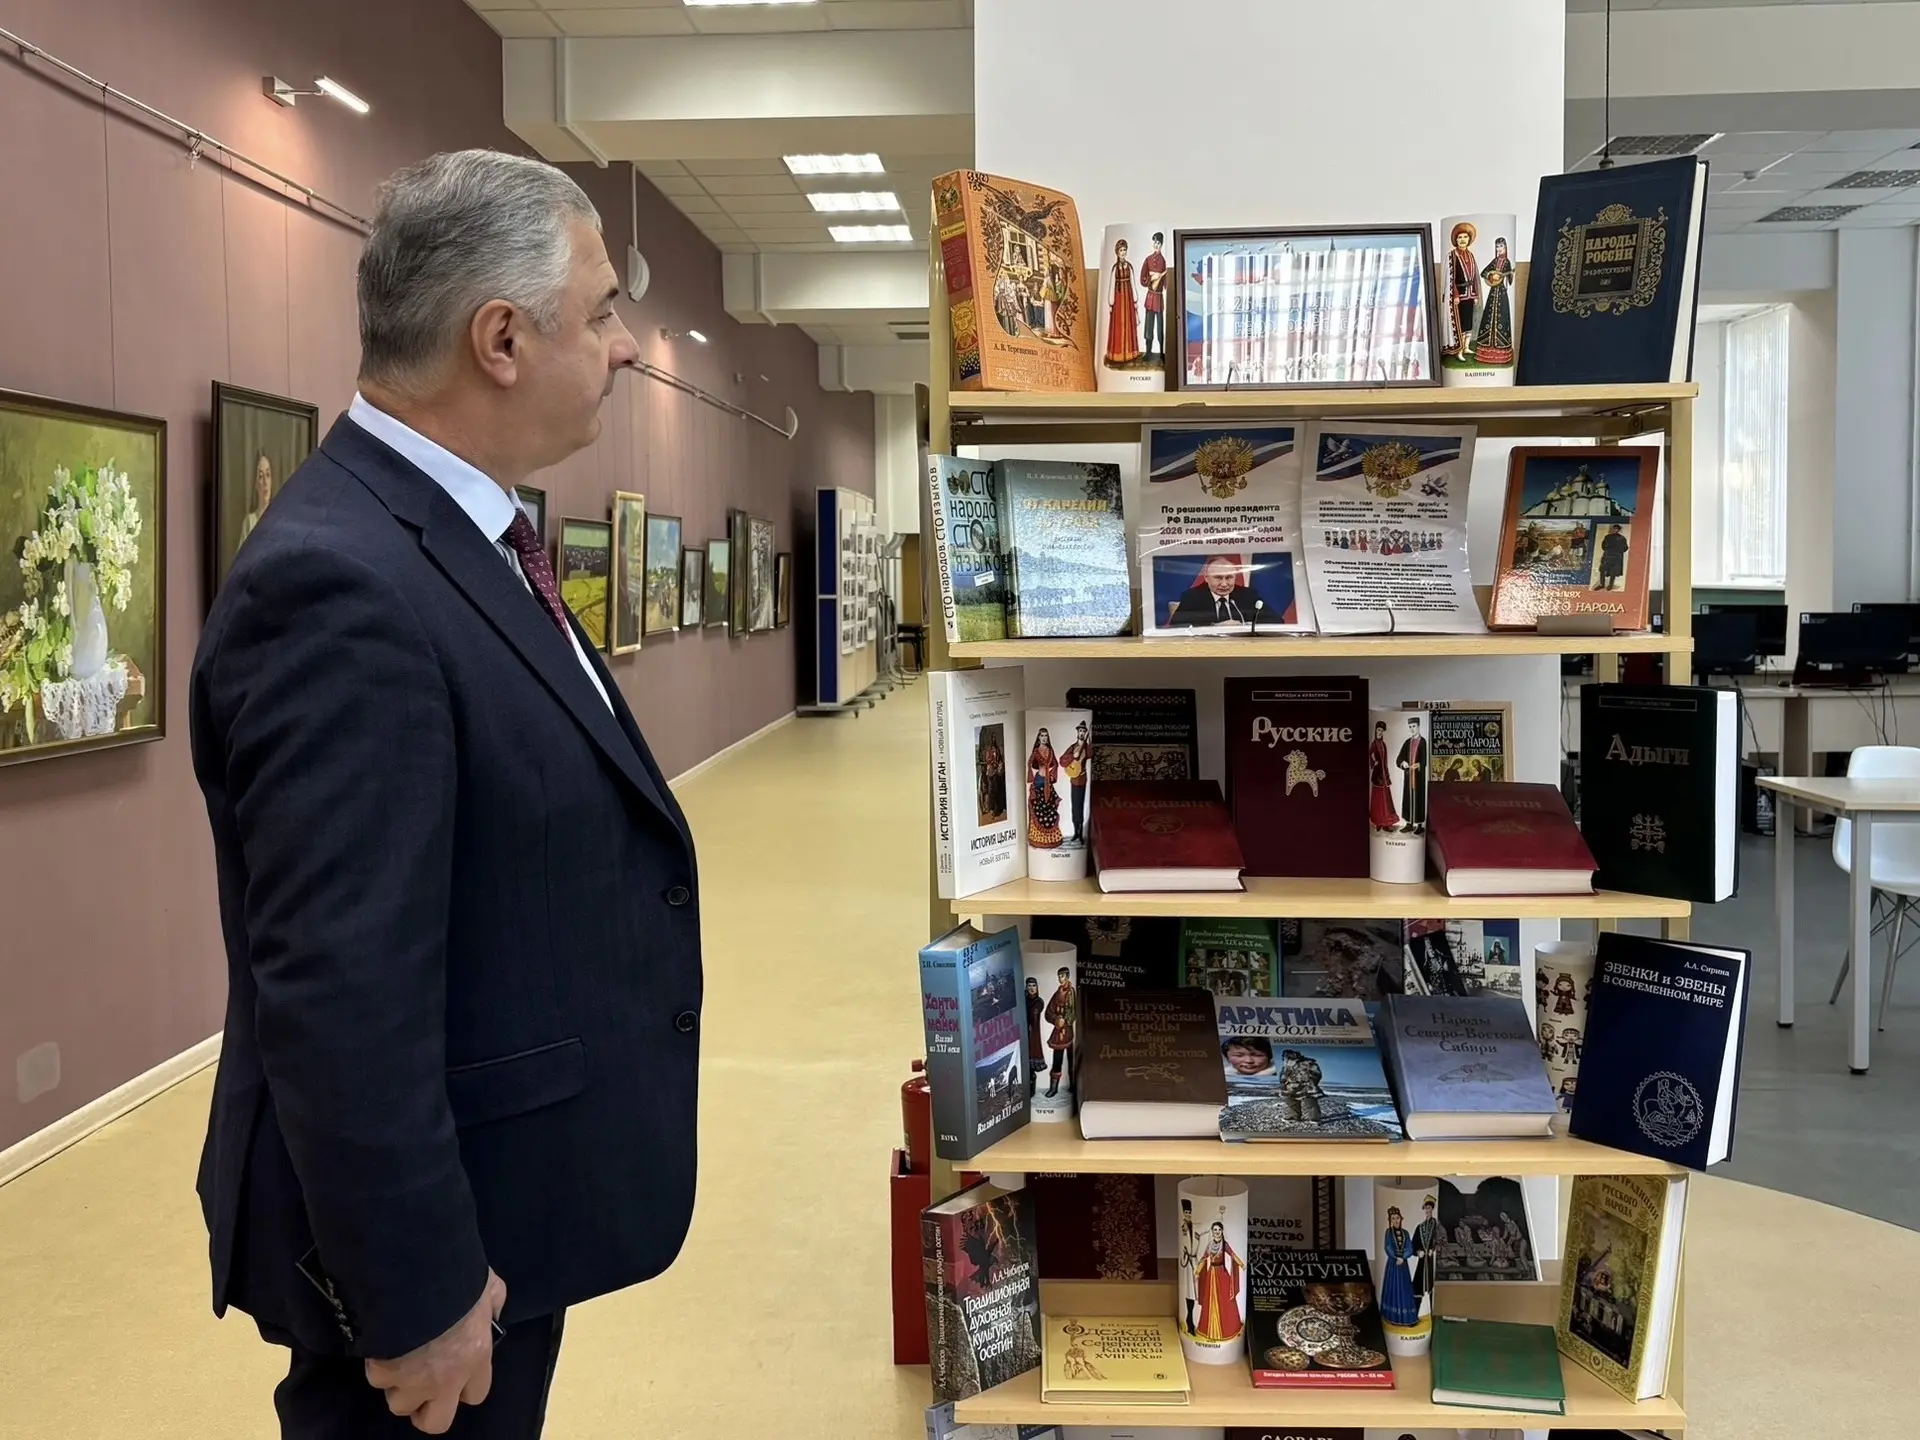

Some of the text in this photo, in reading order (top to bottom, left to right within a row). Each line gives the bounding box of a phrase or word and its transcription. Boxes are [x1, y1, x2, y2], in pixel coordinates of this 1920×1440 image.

[1584, 233, 1638, 251] НАРОДЫ
[1584, 247, 1635, 264] РОССИИ
[950, 500, 997, 521] народо
[1161, 504, 1280, 515] По решению президента
[1167, 514, 1274, 525] РФ Владимира Путина
[934, 518, 946, 542] СТО
[953, 519, 985, 554] СТО
[1160, 527, 1183, 535] 2026
[1185, 527, 1201, 535] год
[1206, 535, 1283, 545] народов России
[956, 555, 1000, 572] языко
[944, 593, 954, 619] СТО
[1576, 602, 1626, 614] НАРОДА
[1250, 716, 1353, 748] Русские
[1433, 729, 1475, 739] РУССКОГО
[1467, 738, 1501, 748] НАРОДА
[1605, 733, 1690, 766] Адыги
[938, 761, 949, 794] ЦЫГАН
[940, 795, 949, 841] ИСТОРИЯ
[970, 829, 1017, 852] ИСТОРИЯ ЦЫГАН
[1185, 929, 1211, 938] Народы
[1076, 961, 1104, 970] МСКАЯ
[1684, 961, 1730, 977] А.А. Сирина
[1079, 978, 1126, 988] КУЛЬТУРЫ
[1604, 961, 1727, 997] ЭВЕНКИ и ЭВЕНЫ
[1602, 975, 1724, 1008] В СОВРЕМЕННОМ МИРЕ
[925, 993, 959, 1010] Ханты
[1114, 998, 1181, 1014] Тунгусо-
[1094, 1011, 1206, 1024] маньчжурские
[1218, 1005, 1359, 1026] АРКТИКА
[1431, 1012, 1491, 1027] Народы
[1120, 1021, 1180, 1033] народы
[1275, 1024, 1319, 1036] дом
[1404, 1025, 1525, 1041] Северо-Востока
[1128, 1031, 1176, 1045] Сибири
[936, 1044, 947, 1053] XXI
[1099, 1044, 1208, 1059] Дальнего Востока
[1439, 1041, 1498, 1056] Сибири
[1001, 1106, 1012, 1121] XXI
[1602, 1182, 1638, 1208] РУССКОГО
[1621, 1174, 1660, 1221] ТРАДИЦИИ
[1605, 1196, 1632, 1218] НАРОДА
[1248, 1217, 1302, 1229] АРОДНОЕ
[1249, 1230, 1305, 1241] КУССТВО
[1248, 1251, 1319, 1264] ИСТОРИЯ
[991, 1262, 1030, 1285] Л.А. Чибиров
[1250, 1263, 1365, 1279] КУЛЬТУРЫ
[1251, 1278, 1307, 1288] НАРОДОВ
[963, 1276, 1031, 1317] Традиционная
[1252, 1287, 1288, 1296] МИРА
[969, 1302, 1012, 1334] духовная
[972, 1319, 1013, 1350] культура
[1063, 1323, 1162, 1336] Одежда
[1081, 1340, 1163, 1348] Северного
[1101, 1335, 1161, 1343] народов
[979, 1336, 1014, 1362] осетин
